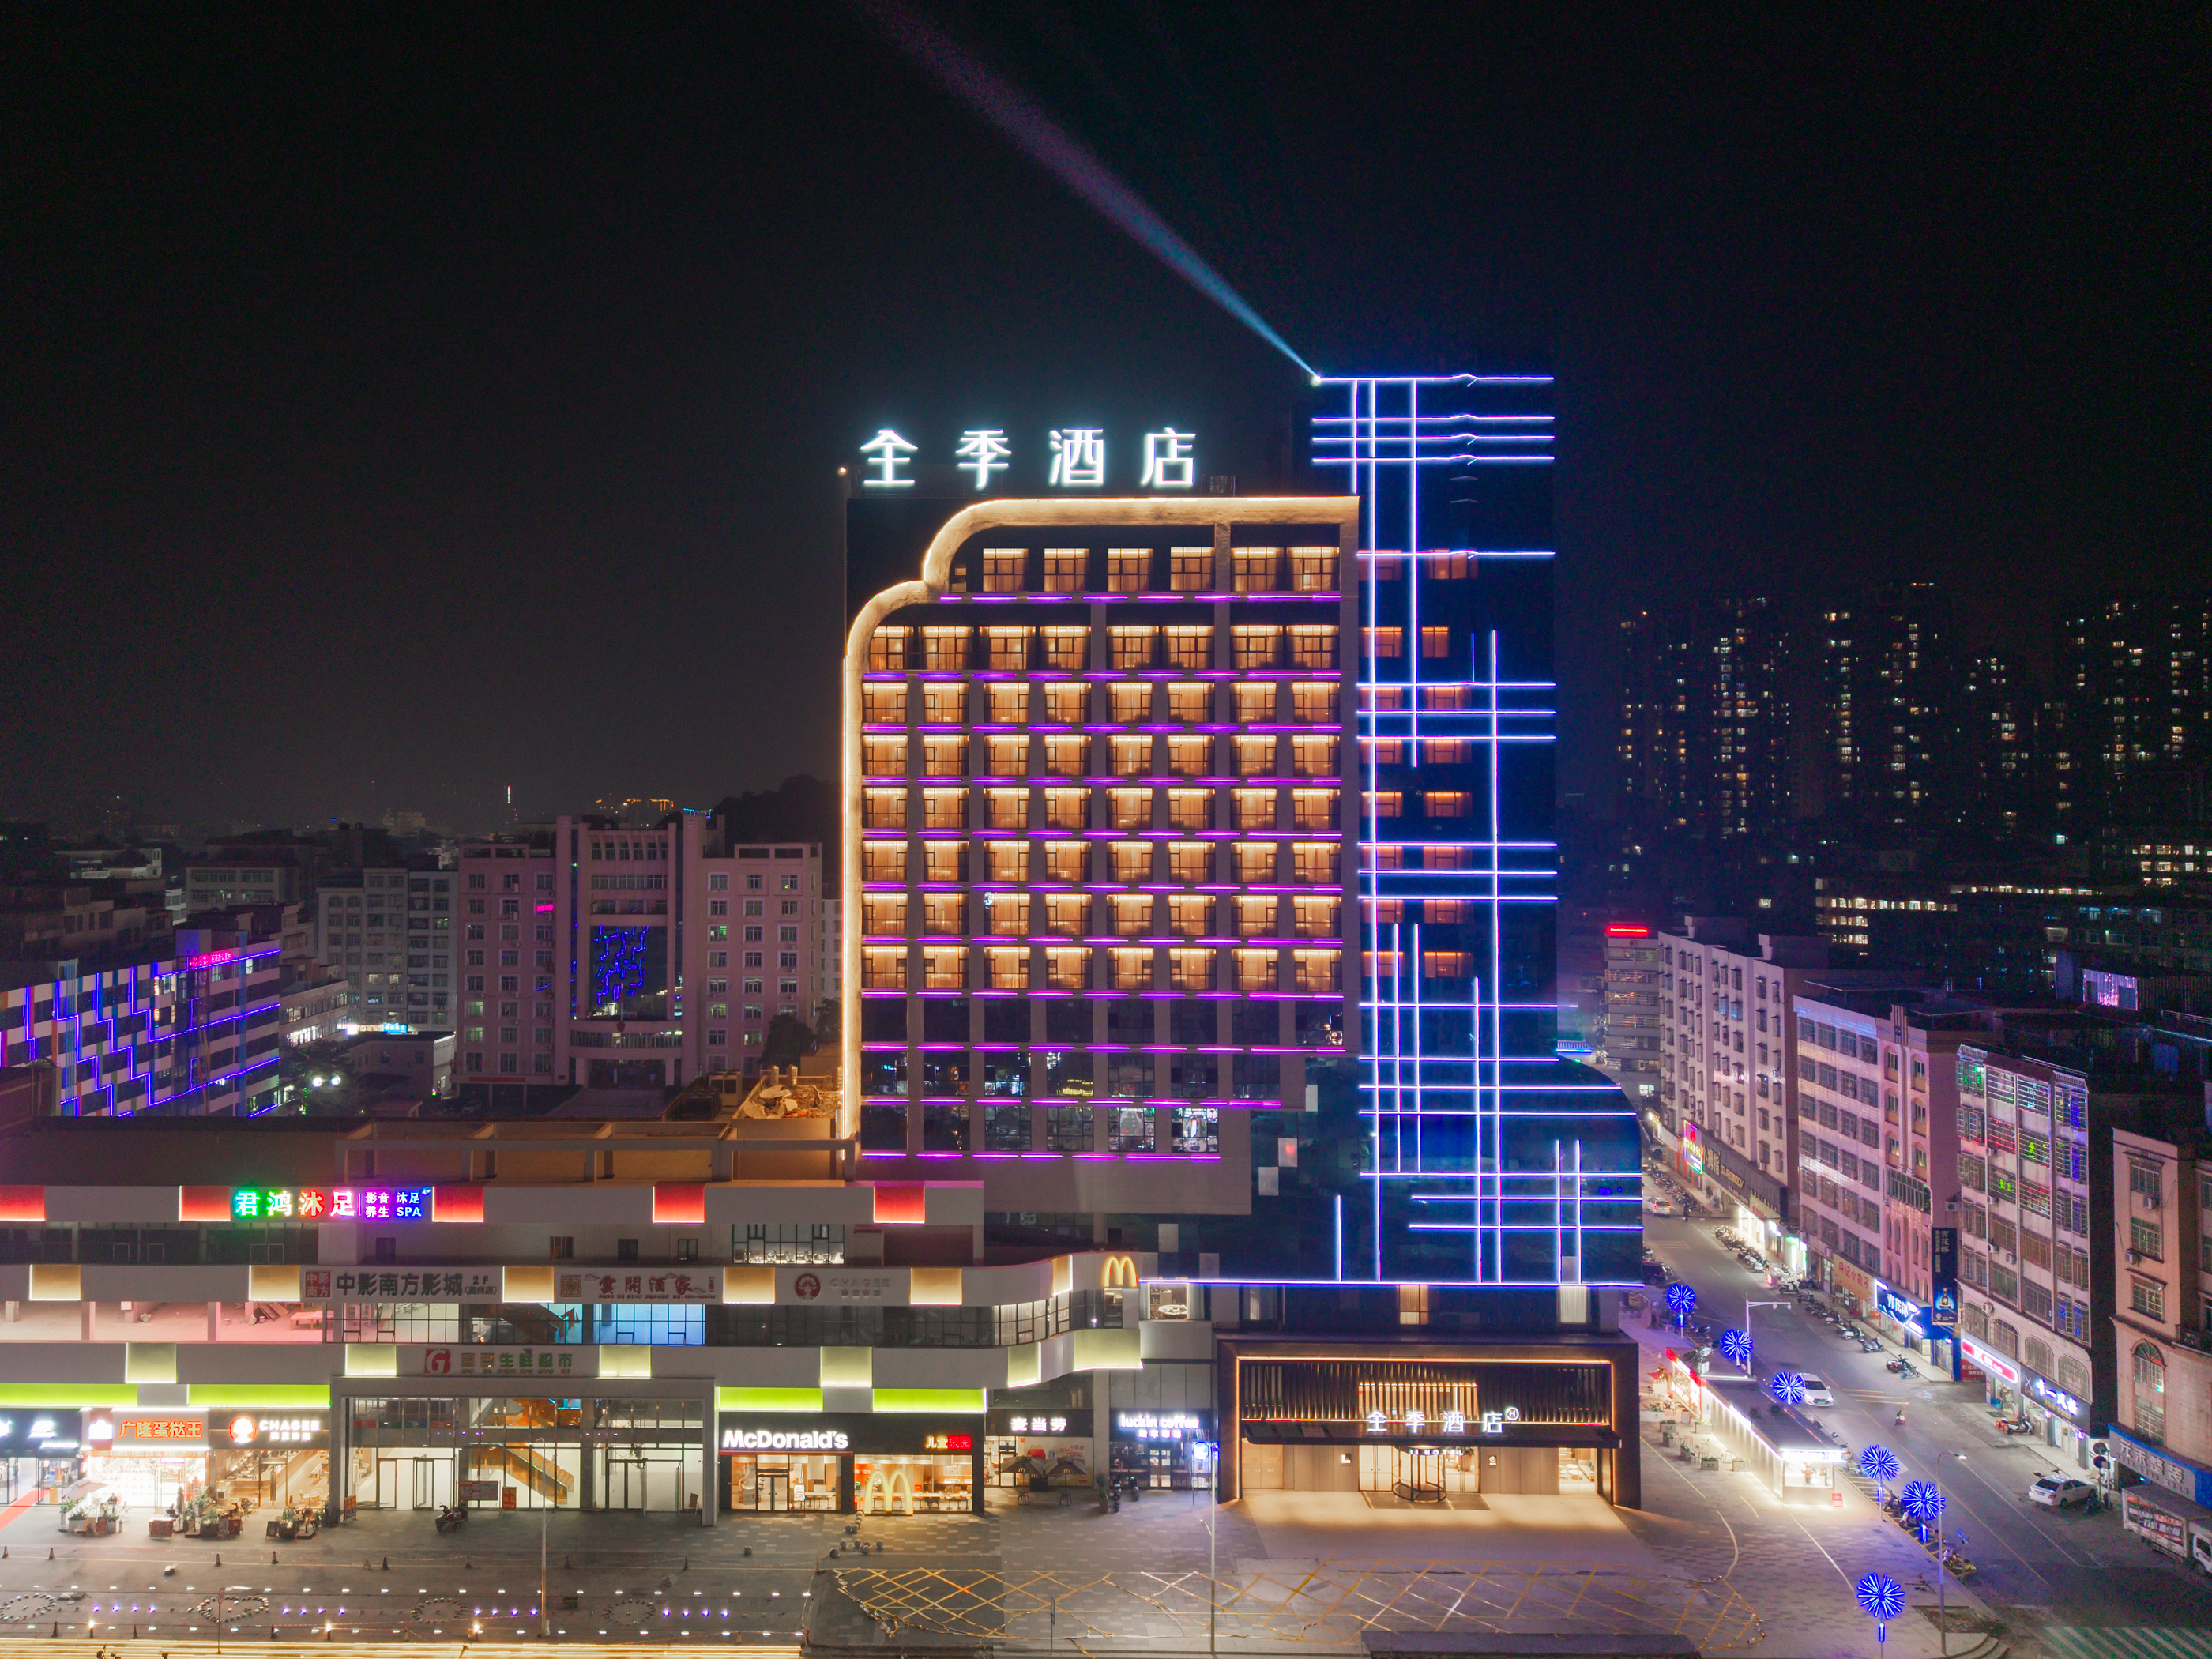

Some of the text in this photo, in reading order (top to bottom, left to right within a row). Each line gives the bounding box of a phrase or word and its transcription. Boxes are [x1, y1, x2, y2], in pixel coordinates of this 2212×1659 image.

[860, 427, 1197, 490] 全季酒店
[235, 1190, 356, 1217] 君鸿沐足
[365, 1191, 420, 1204] 影音 沐足
[365, 1206, 390, 1217] 养生
[396, 1206, 422, 1217] SPA
[306, 1272, 329, 1284] 中影
[336, 1273, 463, 1296] 中影南方影城
[472, 1275, 488, 1285] 2F
[599, 1275, 693, 1296] 雲開酒家
[830, 1278, 890, 1288] CHAGEE
[306, 1286, 329, 1297] 南方
[258, 1420, 320, 1431] CHAGEE
[1011, 1417, 1066, 1432] 麦当劳
[1120, 1413, 1200, 1428] luckin coffee
[1367, 1410, 1503, 1434] 全季酒店
[120, 1421, 203, 1439] 广隆蛋挞王
[722, 1430, 849, 1449] McDonald's
[925, 1435, 972, 1450] 儿童乐园
[1424, 1448, 1464, 1457] HOTEL
